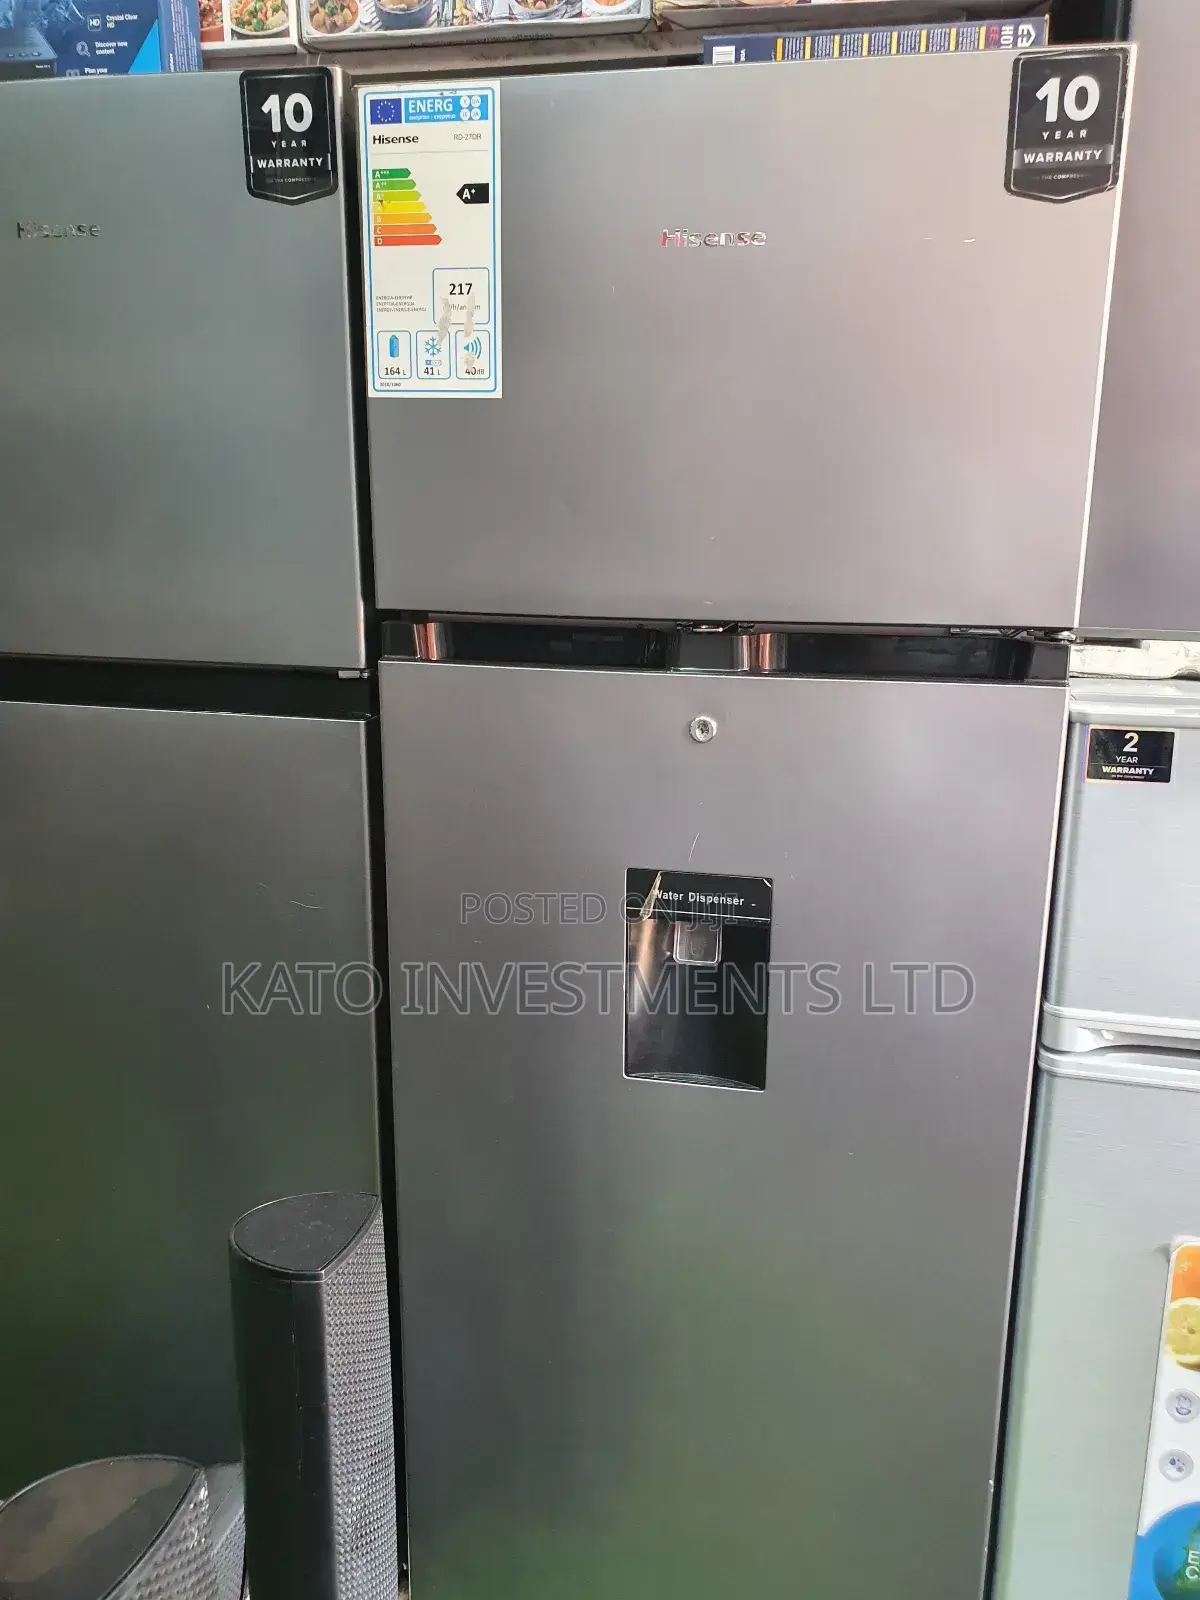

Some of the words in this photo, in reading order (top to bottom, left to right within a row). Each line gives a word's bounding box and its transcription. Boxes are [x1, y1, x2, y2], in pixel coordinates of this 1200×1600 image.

[106, 14, 124, 22] Crystal
[1035, 75, 1100, 122] 10
[408, 98, 453, 113] ENERG
[261, 92, 313, 133] 10
[373, 134, 419, 145] Hisense
[1042, 129, 1087, 140] YEAR
[271, 140, 307, 148] YEAR
[1023, 149, 1103, 164] WARRANTY
[257, 157, 323, 169] WARRANTY
[462, 187, 476, 200] A+
[660, 228, 767, 248] Hisense
[449, 283, 473, 296] 217
[384, 366, 401, 376] 164
[423, 366, 435, 376] 41
[1122, 732, 1139, 752] 2
[1115, 755, 1139, 764] YEAR
[1102, 765, 1155, 776] WARRANTY
[688, 891, 745, 906] Dispenser
